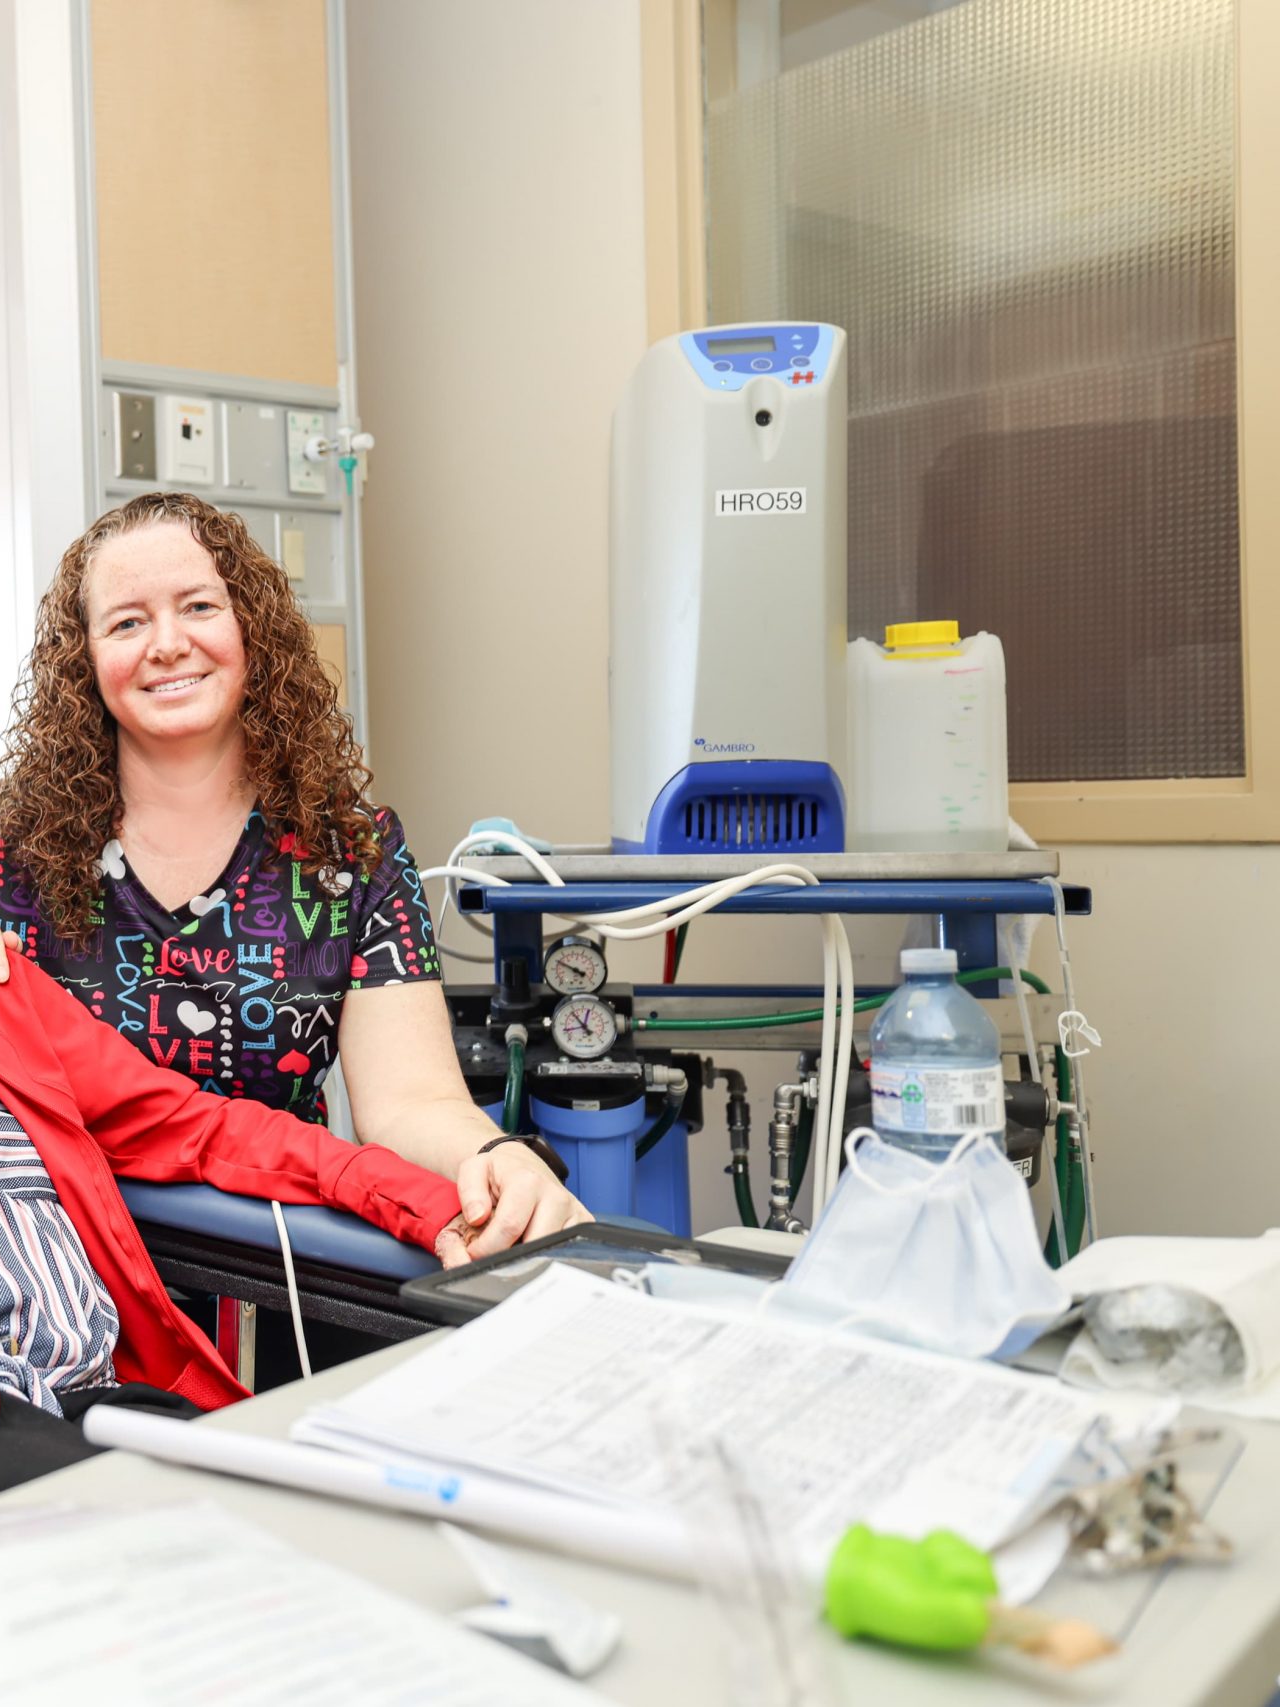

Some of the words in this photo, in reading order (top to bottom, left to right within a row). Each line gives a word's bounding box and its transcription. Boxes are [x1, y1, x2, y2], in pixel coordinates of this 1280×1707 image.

[703, 743, 755, 753] GAMBRO
[154, 936, 236, 976] Love
[237, 943, 276, 1050] LOVE
[271, 982, 347, 1004] Love
